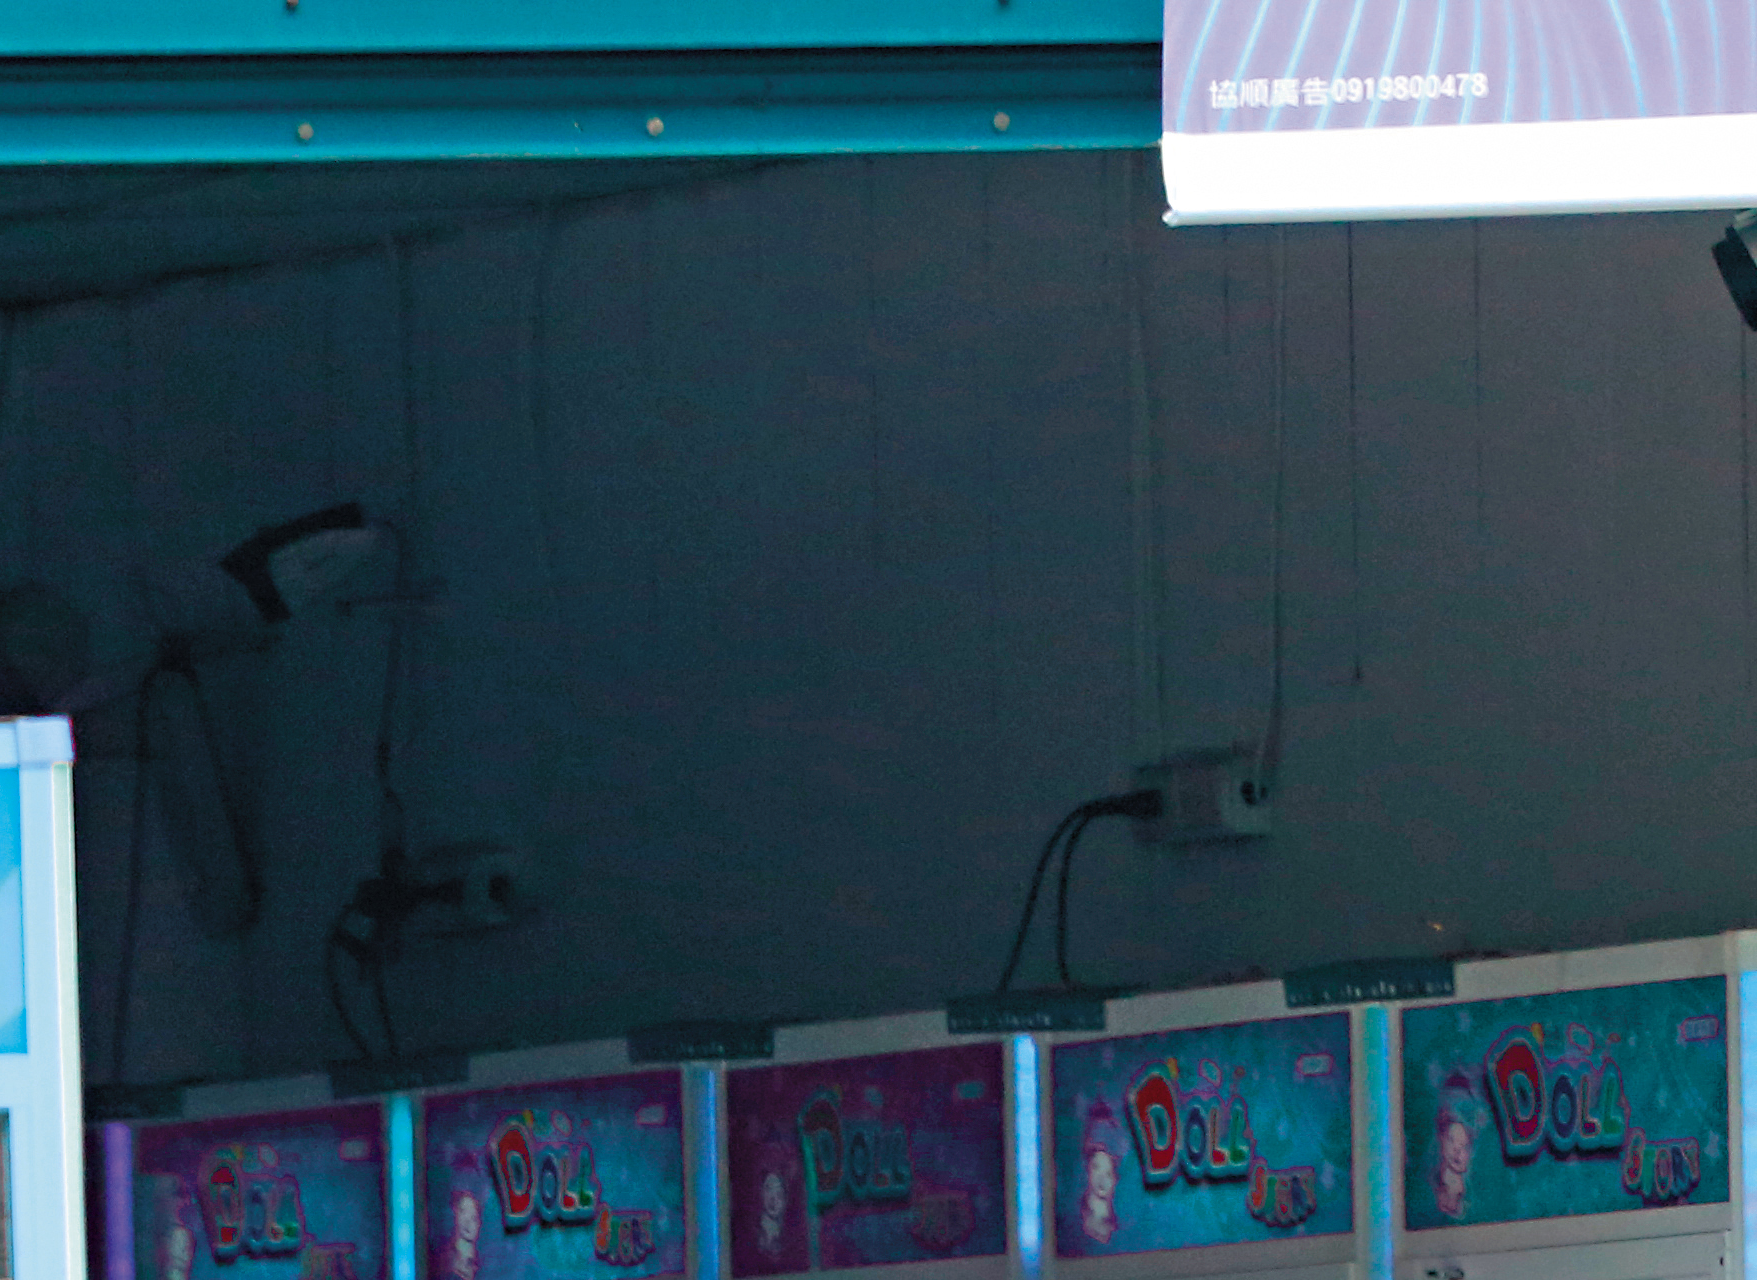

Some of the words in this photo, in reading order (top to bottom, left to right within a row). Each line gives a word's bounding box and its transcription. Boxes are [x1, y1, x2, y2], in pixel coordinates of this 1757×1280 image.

[1130, 1070, 1252, 1180] DOLL
[1489, 1038, 1625, 1152] DOLL
[490, 1122, 596, 1224] DOLL
